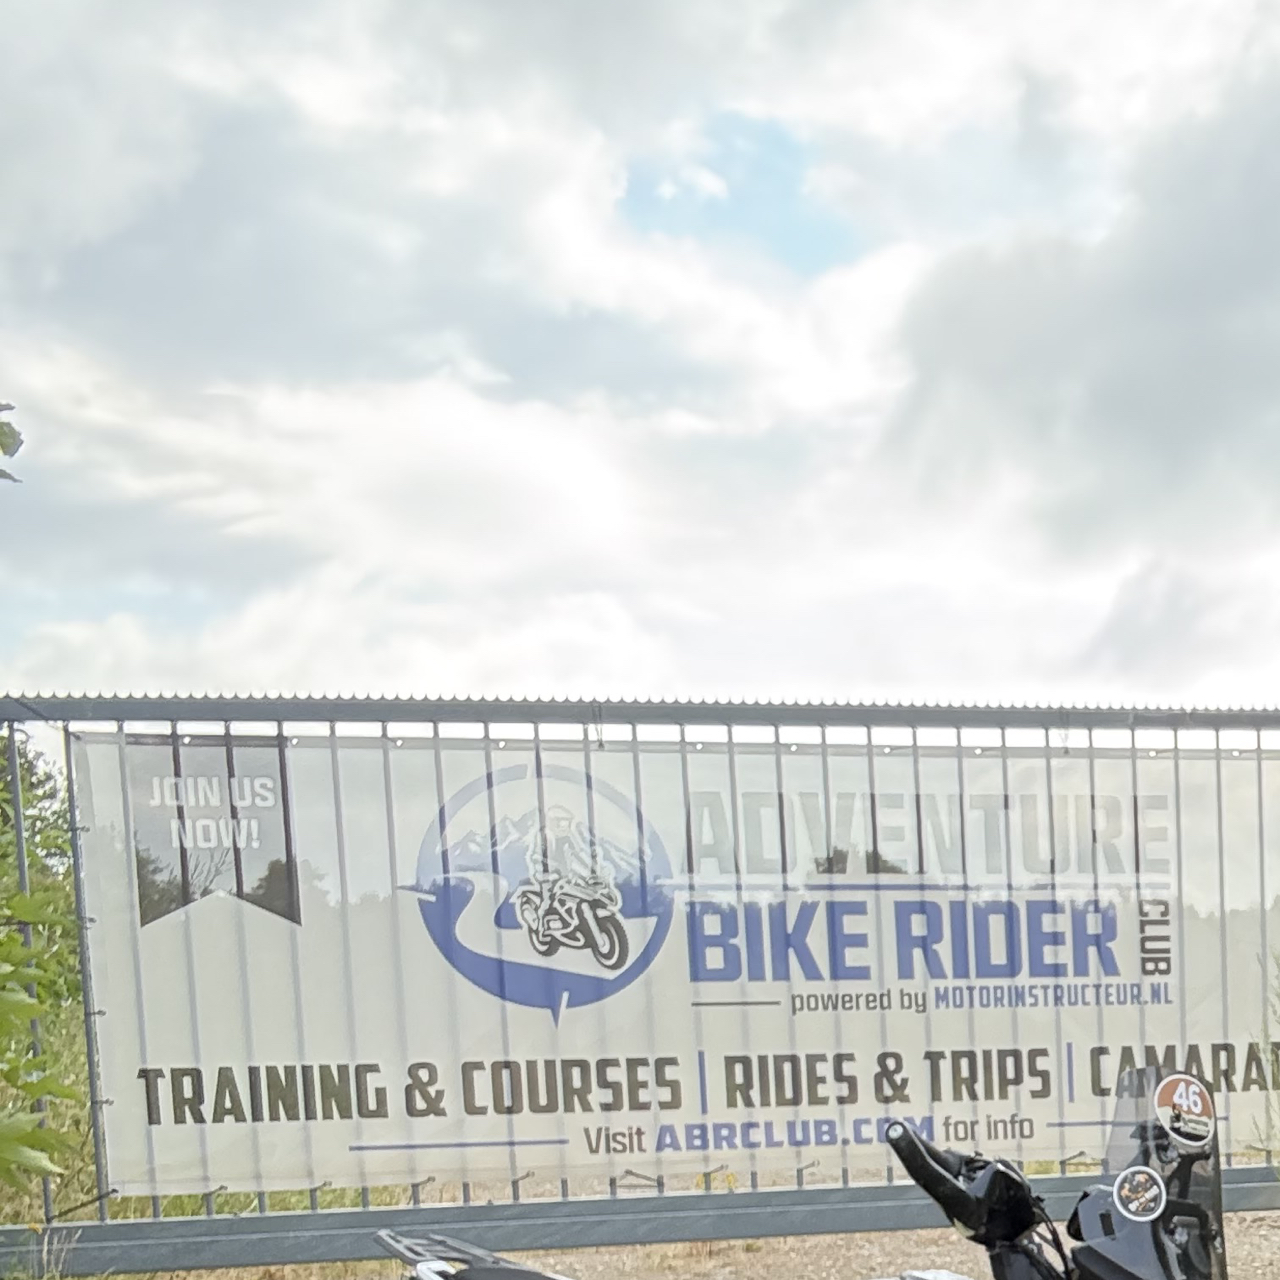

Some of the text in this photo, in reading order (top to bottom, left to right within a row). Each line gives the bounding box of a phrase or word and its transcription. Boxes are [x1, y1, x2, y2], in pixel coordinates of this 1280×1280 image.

[149, 776, 276, 807] JOIN US
[170, 818, 260, 849] NOW!
[688, 791, 1171, 875] ADVENTURE
[685, 899, 1122, 982] BIKE RIDER
[1139, 899, 1171, 976] CLUB
[791, 982, 1173, 1016] powered by MOTORINSTRUCTEUR.NL
[137, 1056, 682, 1126] TRAINING & COURSES
[724, 1048, 1051, 1108] RIDES & TRIPS
[1173, 1081, 1203, 1114] 46
[583, 1126, 646, 1154] Visit
[943, 1115, 979, 1142] for
[987, 1113, 1034, 1141] info
